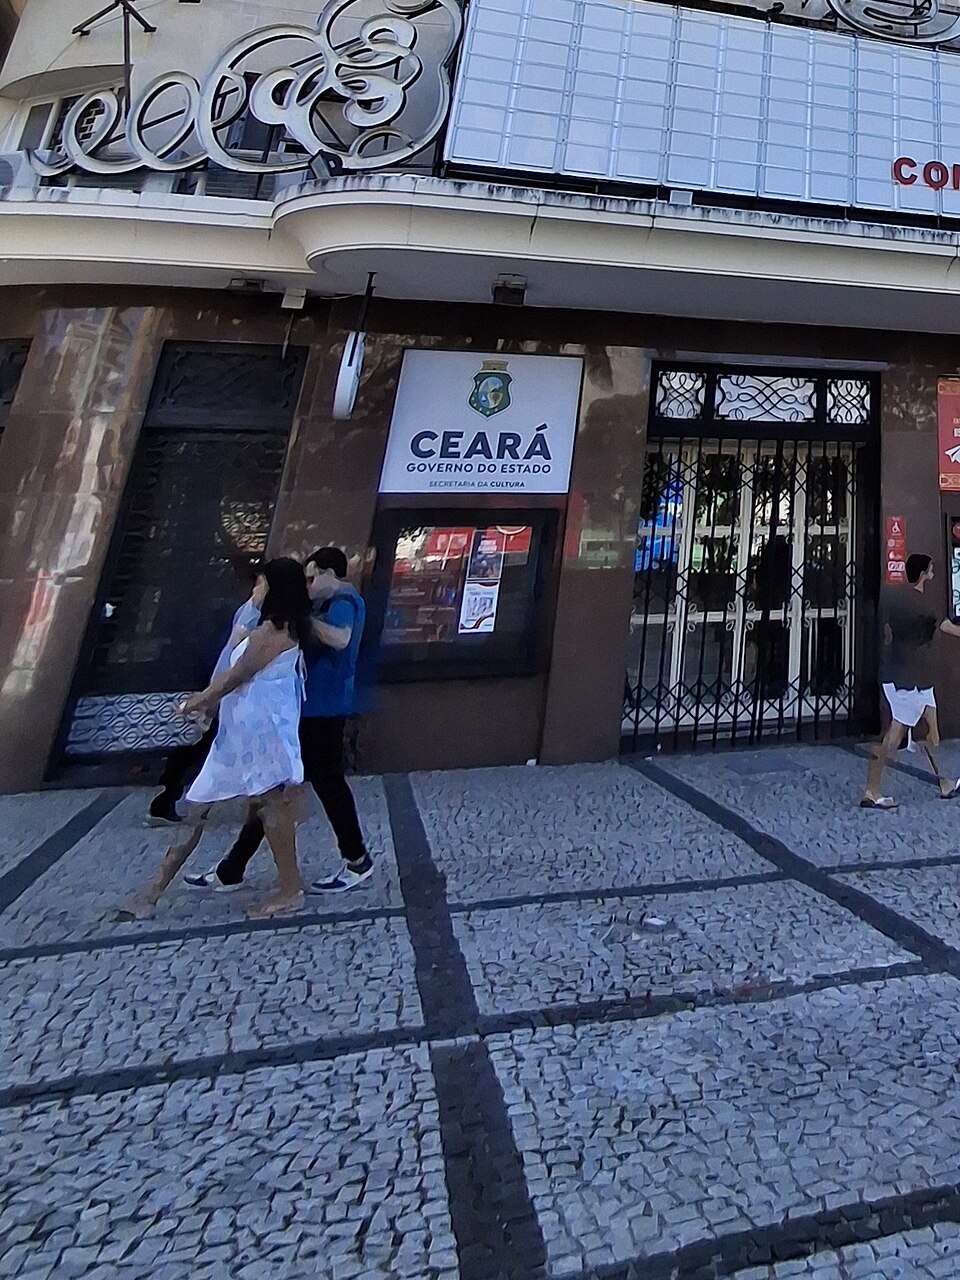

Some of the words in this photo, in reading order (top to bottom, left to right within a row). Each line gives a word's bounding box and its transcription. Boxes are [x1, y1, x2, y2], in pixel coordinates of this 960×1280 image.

[410, 423, 552, 460] CEARÁ
[406, 462, 473, 473] GOVERNO
[477, 463, 497, 473] DO
[500, 464, 551, 474] ESTADO
[429, 480, 475, 488] SECRETARIA
